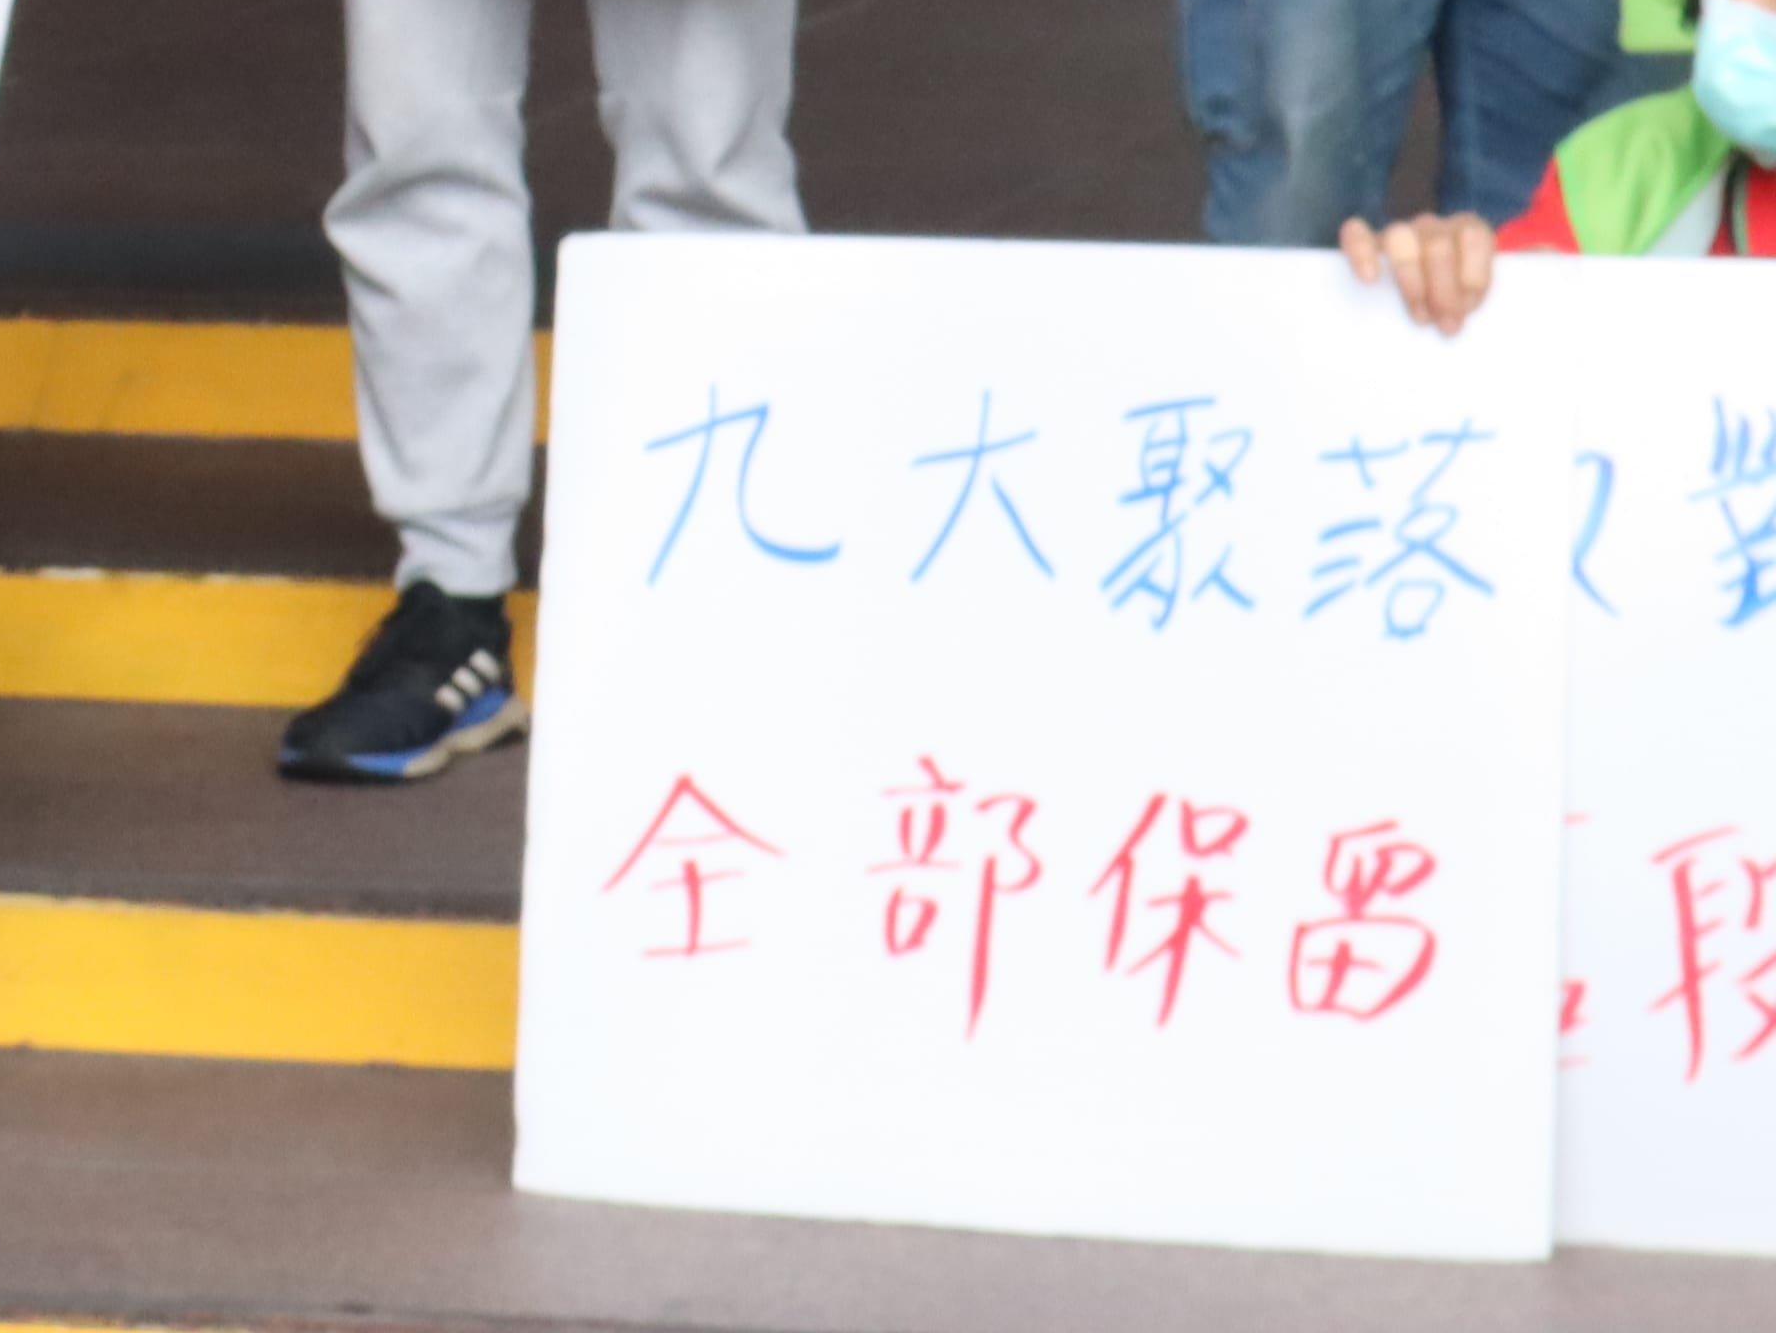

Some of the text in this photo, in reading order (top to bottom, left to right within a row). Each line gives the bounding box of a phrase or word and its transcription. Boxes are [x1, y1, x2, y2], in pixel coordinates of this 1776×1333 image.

[645, 383, 1498, 643] 九大聚落
[602, 753, 1440, 1041] 全部保留
